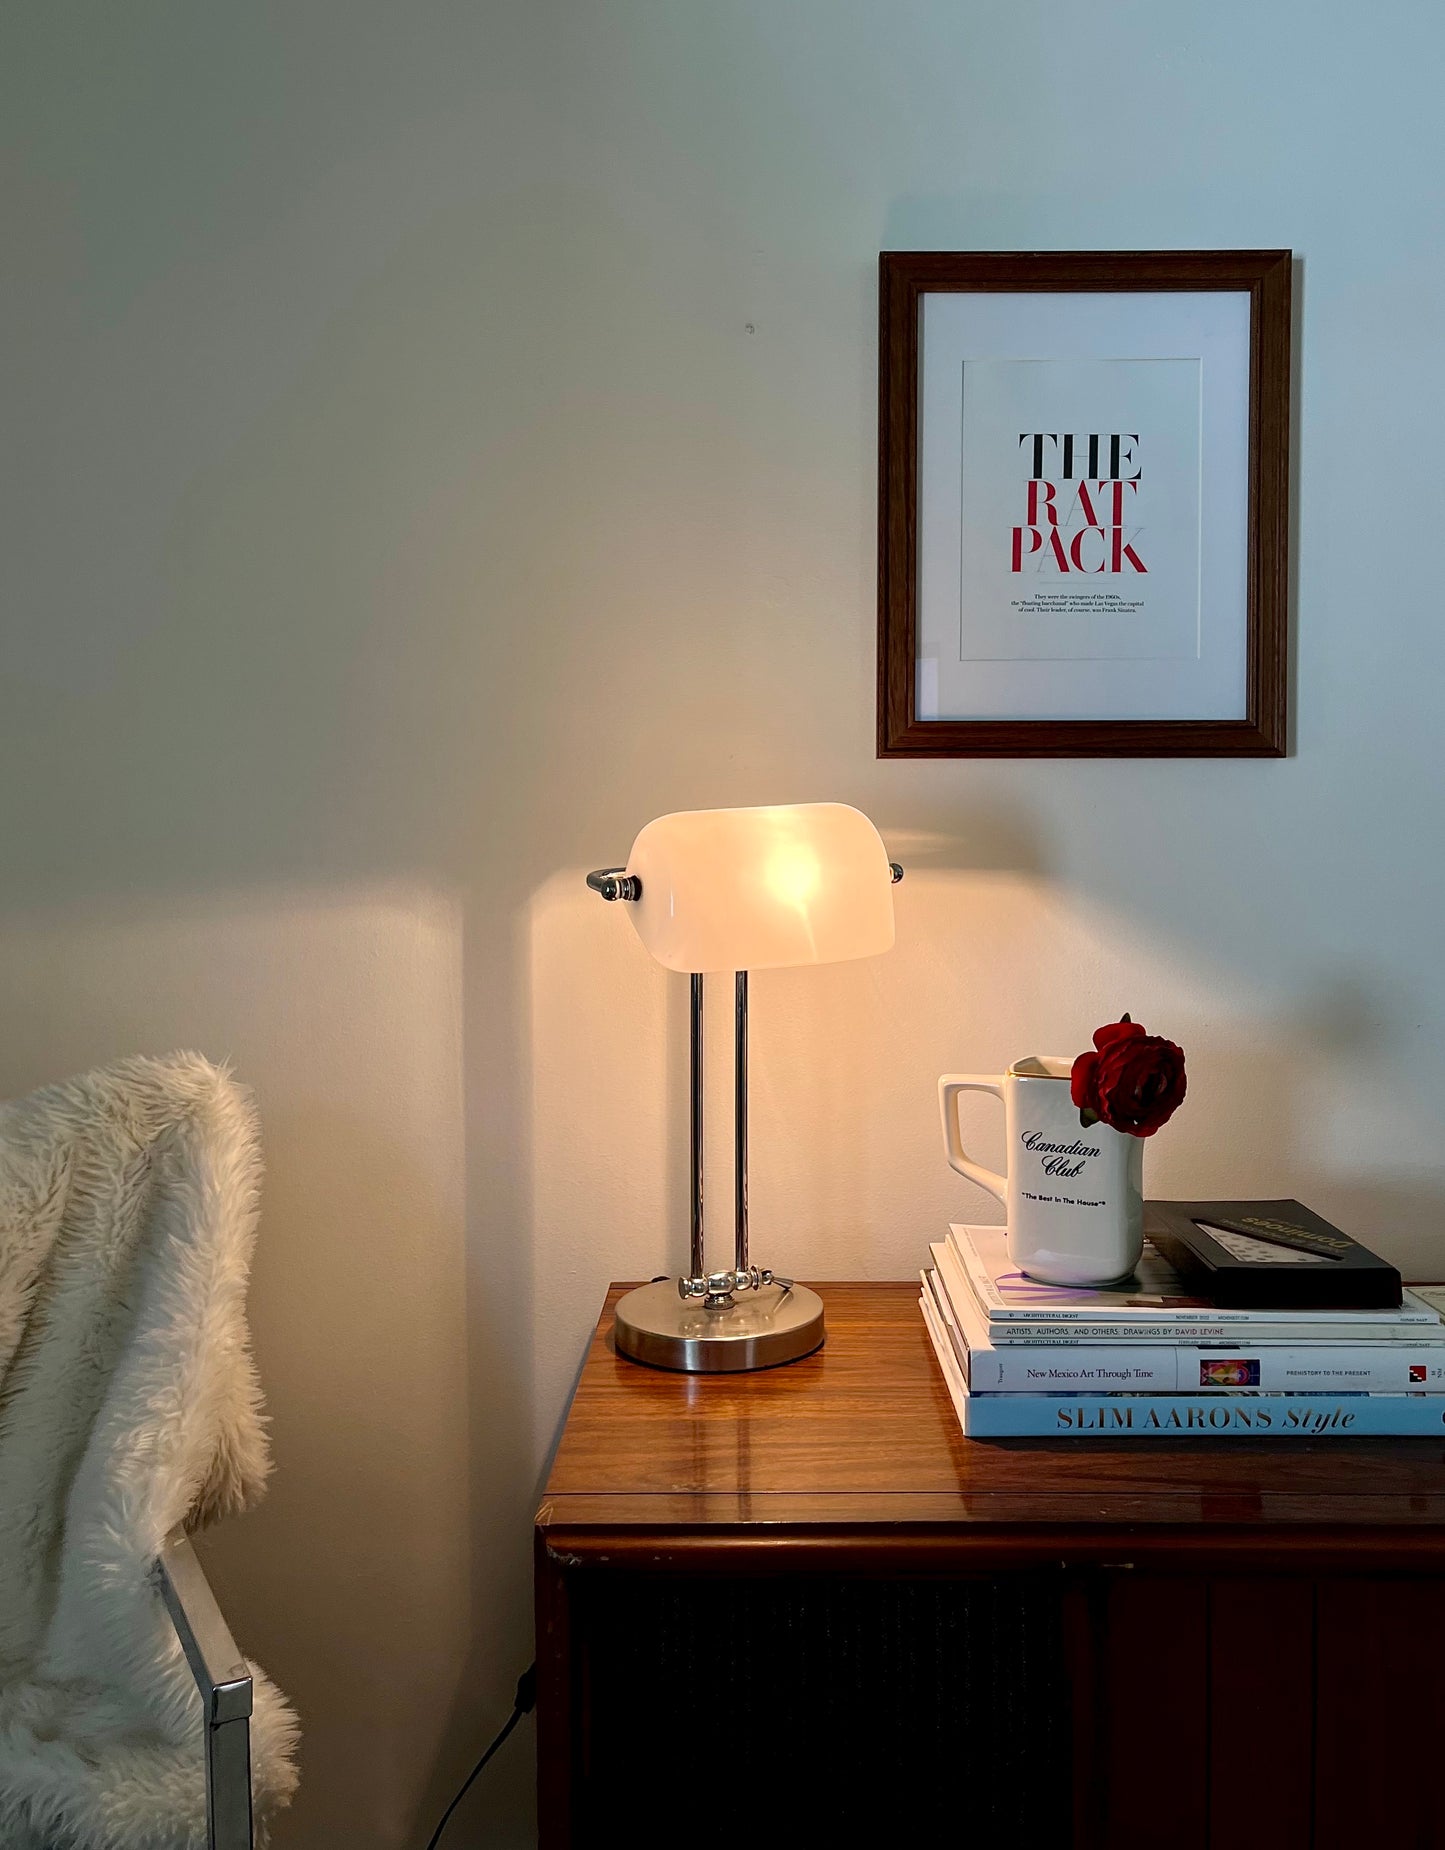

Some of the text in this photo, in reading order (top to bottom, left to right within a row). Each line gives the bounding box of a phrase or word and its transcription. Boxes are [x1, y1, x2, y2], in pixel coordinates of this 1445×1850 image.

[1018, 433, 1142, 480] THE
[1024, 480, 1137, 526] RAT
[1007, 526, 1148, 574] PACK
[1021, 1131, 1101, 1157] Canadian
[1042, 1156, 1086, 1178] Club
[1241, 1217, 1354, 1248] Dominoes
[1027, 1369, 1153, 1380] New Mexico Art Through Time
[1057, 1404, 1356, 1434] SLIM AARONS Style
